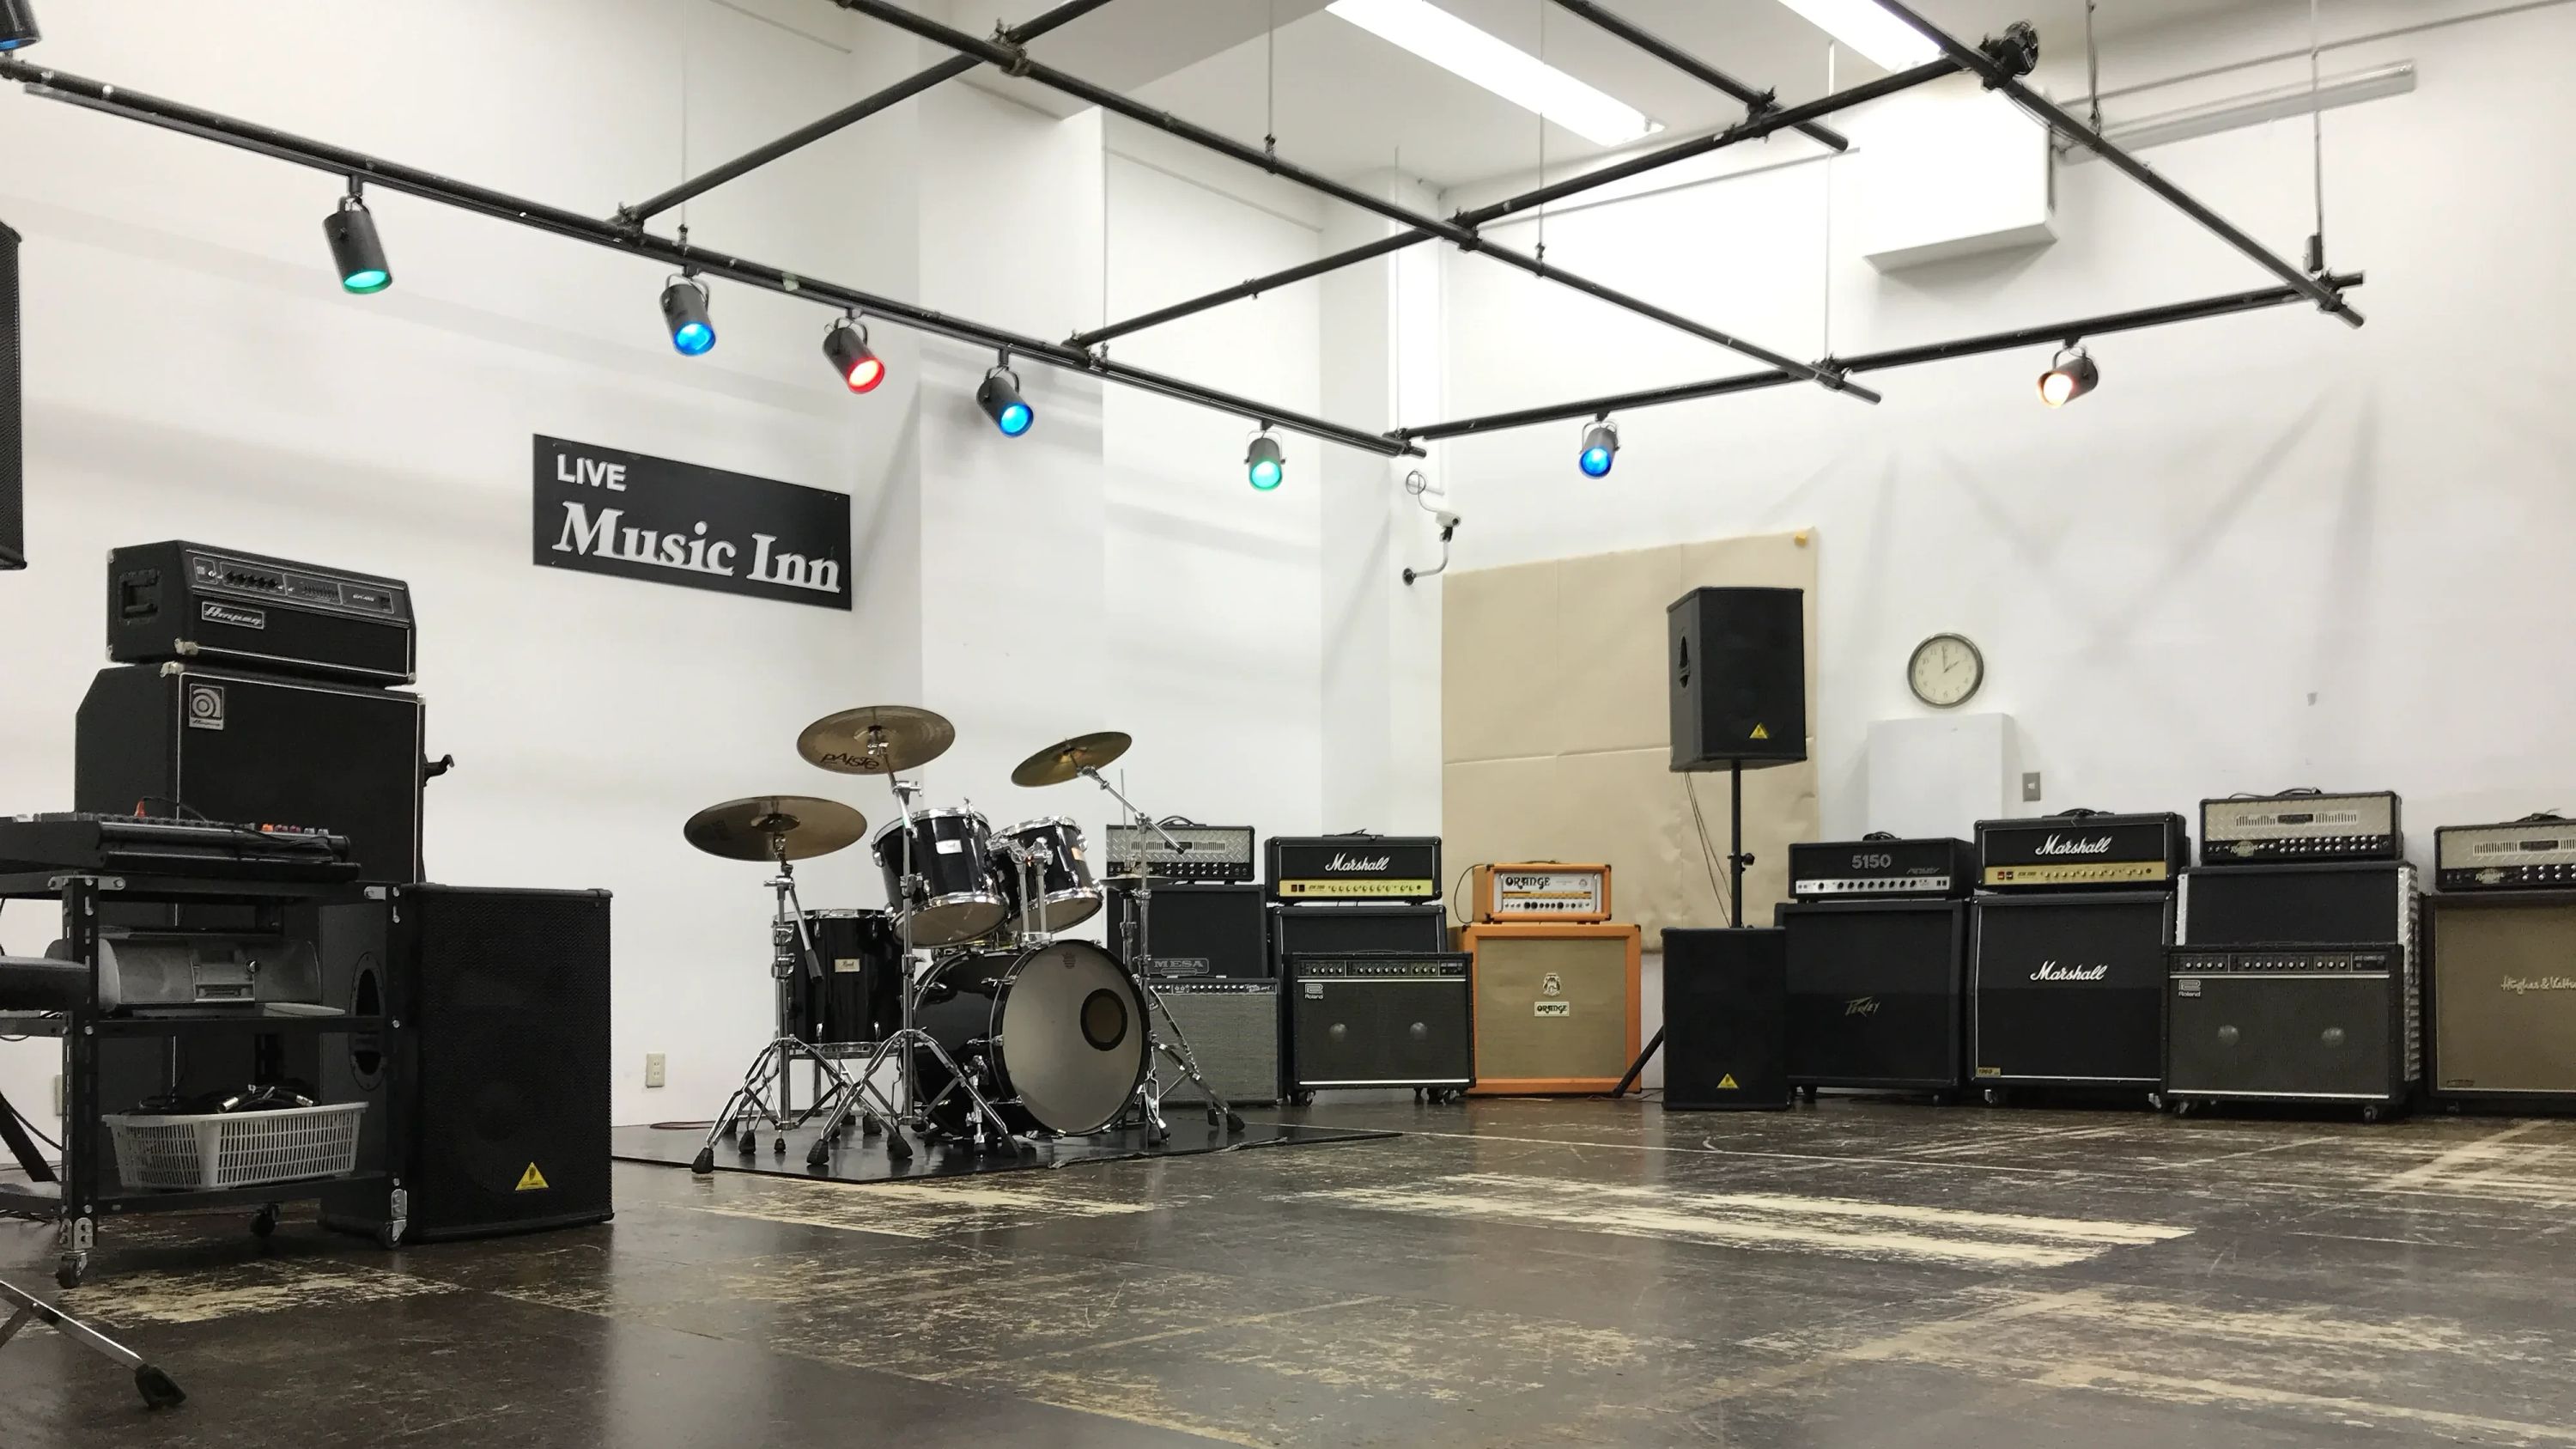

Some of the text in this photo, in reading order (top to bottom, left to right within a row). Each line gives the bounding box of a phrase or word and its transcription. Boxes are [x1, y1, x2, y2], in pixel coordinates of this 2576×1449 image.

[556, 454, 627, 491] LIVE
[552, 501, 841, 594] Music Inn
[204, 606, 262, 625] Ampeg
[2035, 833, 2112, 855] Marshall
[1325, 852, 1390, 872] Marshall
[1851, 854, 1892, 869] 5150
[2030, 960, 2108, 980] Marshall
